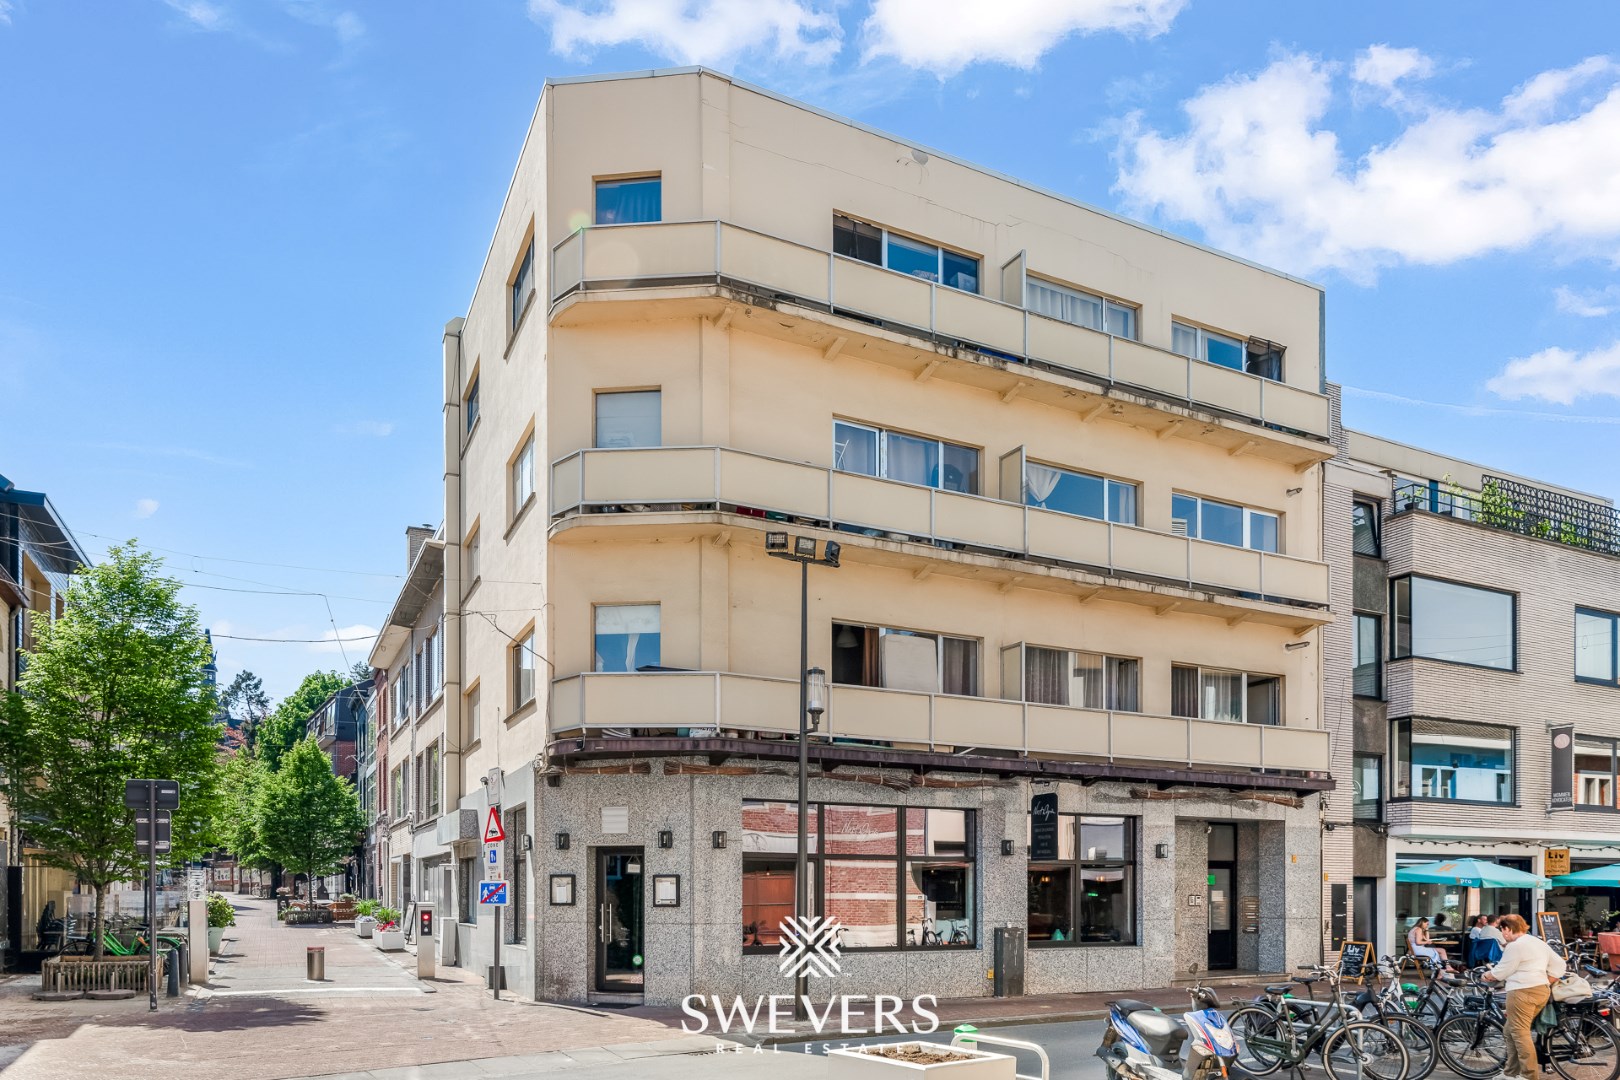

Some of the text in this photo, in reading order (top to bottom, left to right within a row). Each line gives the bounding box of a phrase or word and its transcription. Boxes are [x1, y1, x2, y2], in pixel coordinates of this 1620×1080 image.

[1548, 851, 1564, 859] Liv
[1544, 914, 1555, 923] Liv
[1347, 944, 1360, 953] Liv
